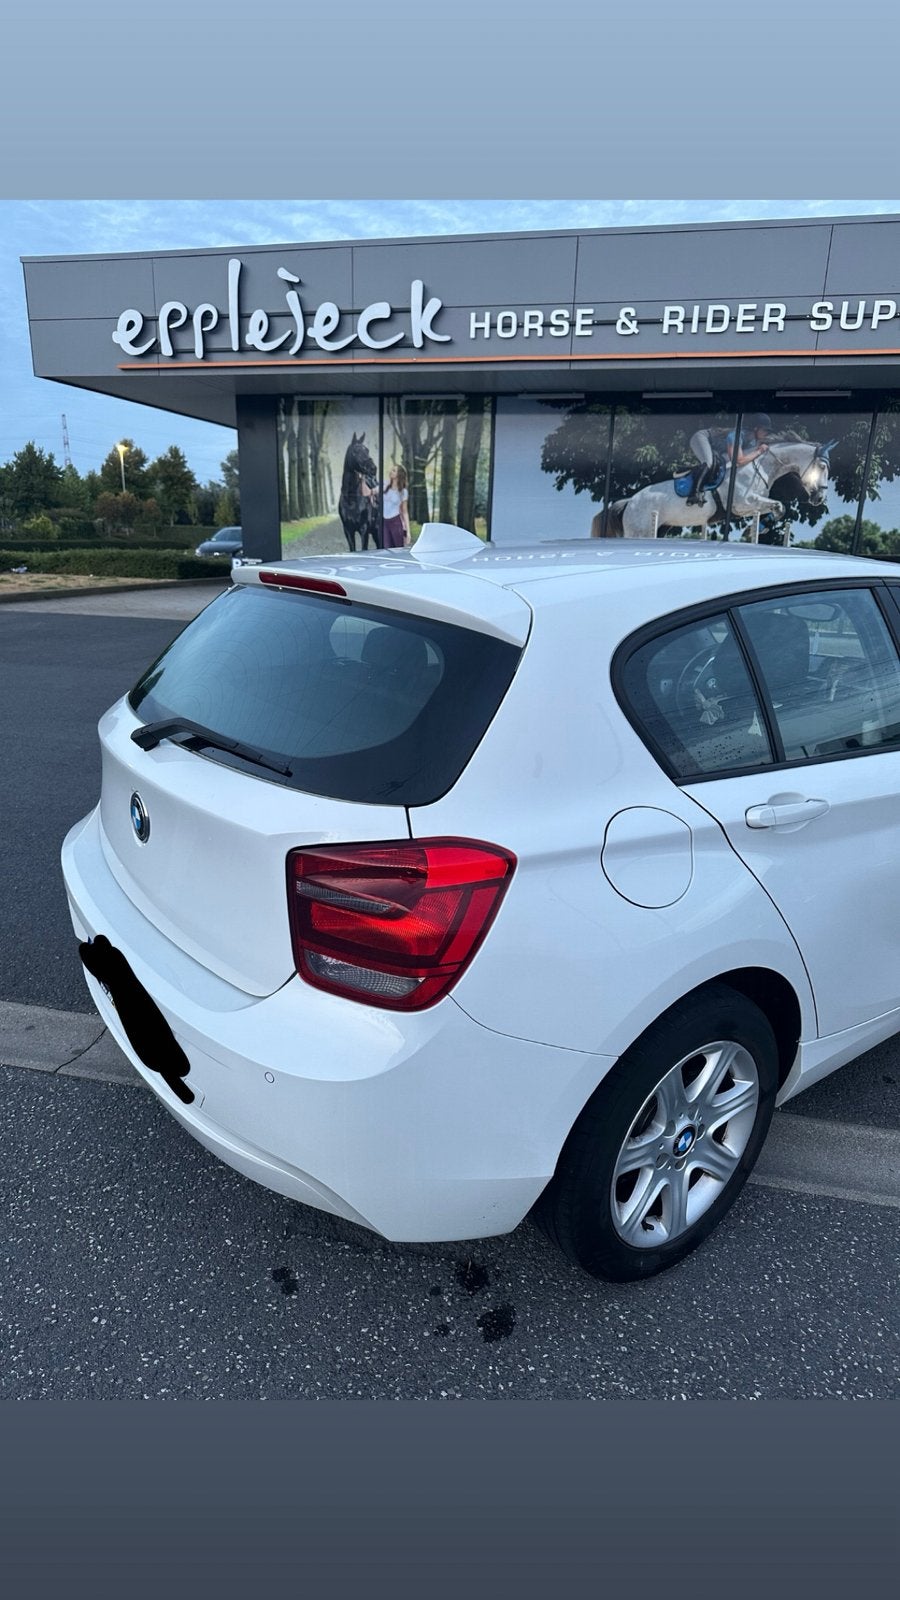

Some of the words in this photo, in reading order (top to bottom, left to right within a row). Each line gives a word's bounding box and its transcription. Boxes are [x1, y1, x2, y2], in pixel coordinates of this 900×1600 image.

[112, 258, 452, 359] epplejeck
[469, 308, 594, 340] HORSE
[615, 306, 640, 335] &
[661, 303, 787, 334] RIDER
[809, 299, 897, 331] SUP
